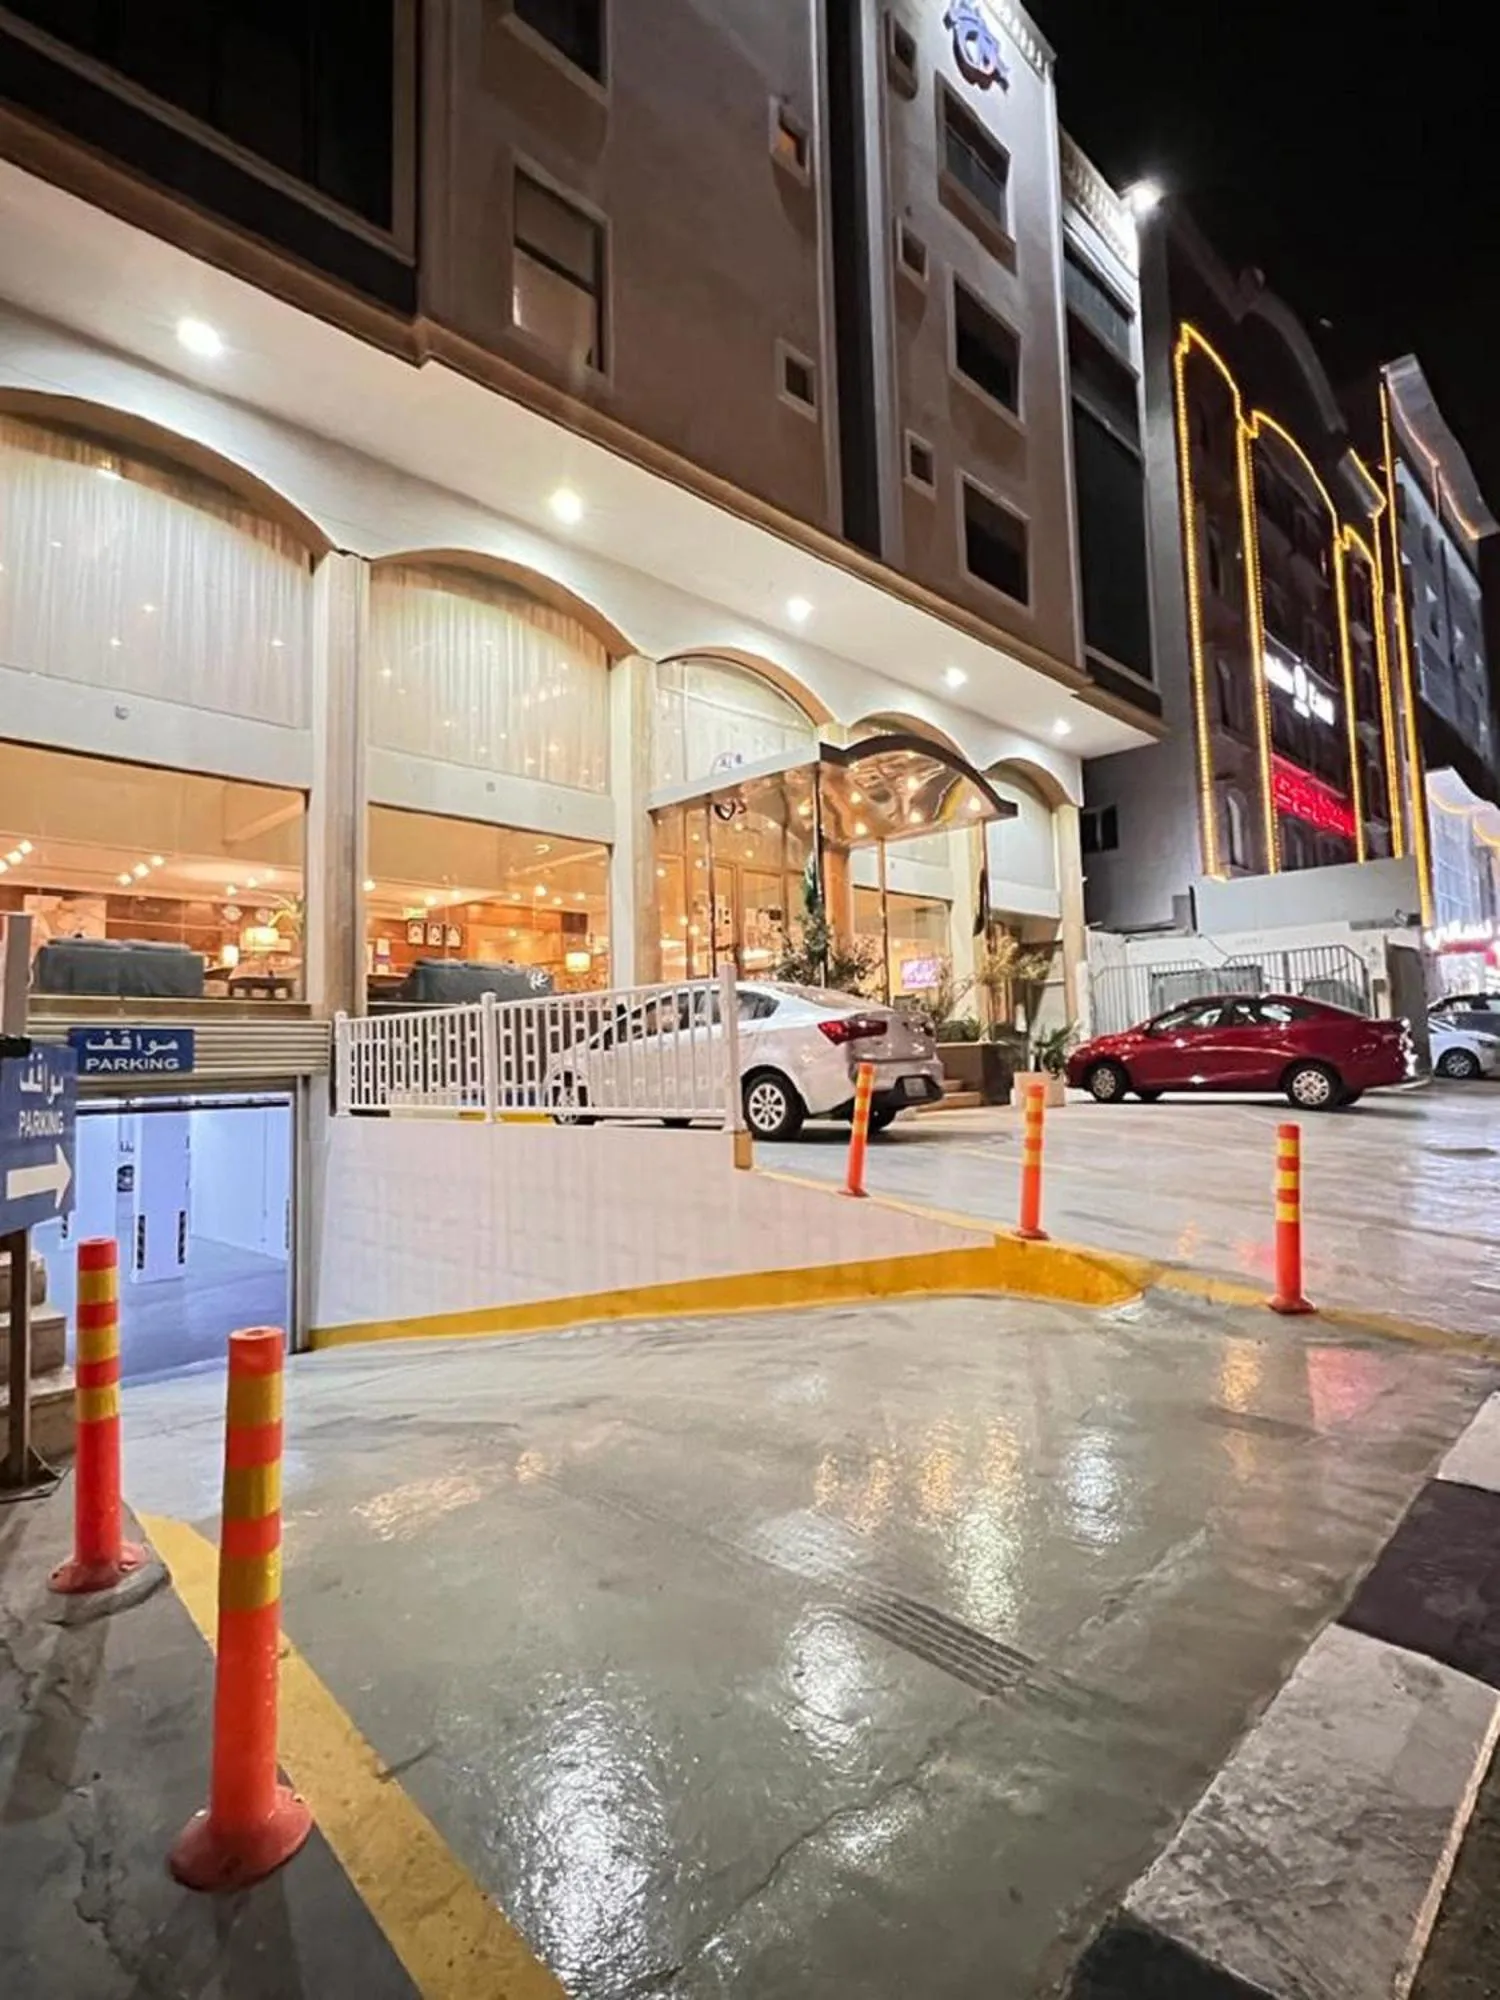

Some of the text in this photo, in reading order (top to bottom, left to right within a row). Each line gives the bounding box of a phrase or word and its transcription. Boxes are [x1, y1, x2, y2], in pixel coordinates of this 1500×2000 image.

[86, 1030, 178, 1056] مواقف
[86, 1057, 180, 1070] PARKING
[19, 1110, 64, 1138] PARKING
